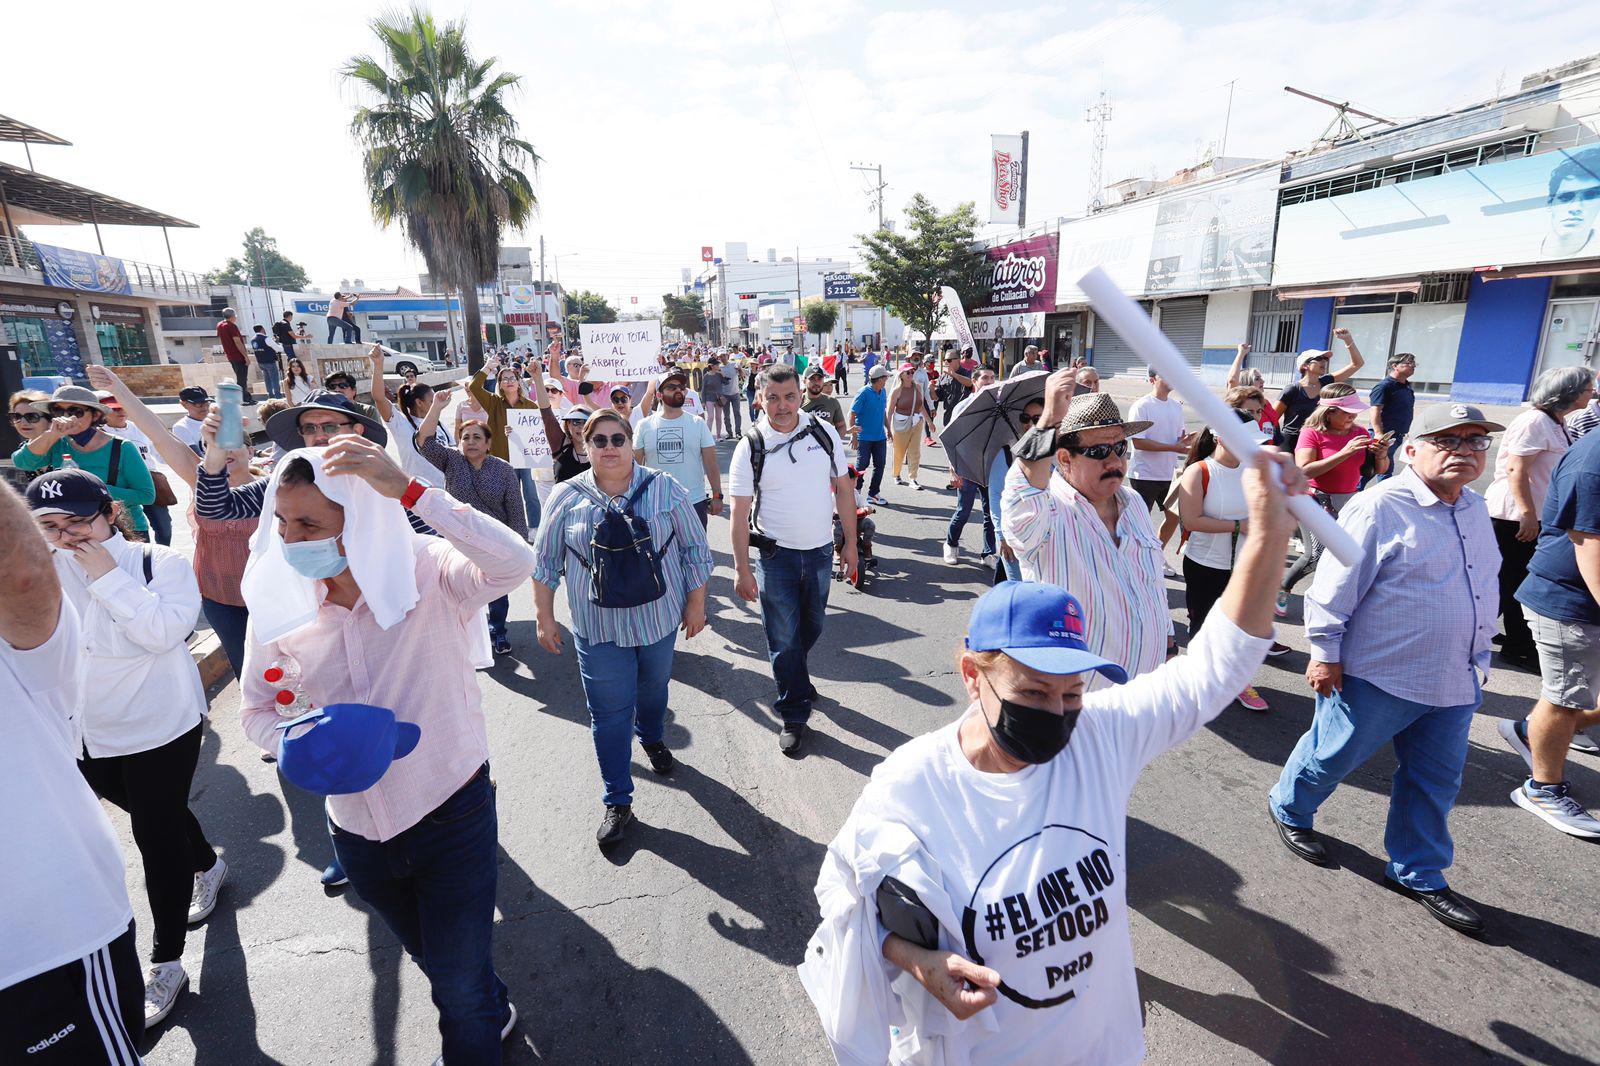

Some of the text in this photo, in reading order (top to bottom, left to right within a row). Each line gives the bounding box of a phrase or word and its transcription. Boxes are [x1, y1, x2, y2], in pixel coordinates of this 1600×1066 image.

[992, 288, 1028, 302] de Culiacán
[627, 330, 653, 343] TOTAL
[611, 346, 626, 355] AL
[591, 356, 627, 368] ÁRBITRO
[528, 433, 548, 445] ÁRB
[41, 480, 63, 498] NY
[1037, 867, 1080, 918] INE
[1076, 849, 1114, 896] NO
[1045, 951, 1094, 989] PRD
[27, 1023, 76, 1054] adidas
